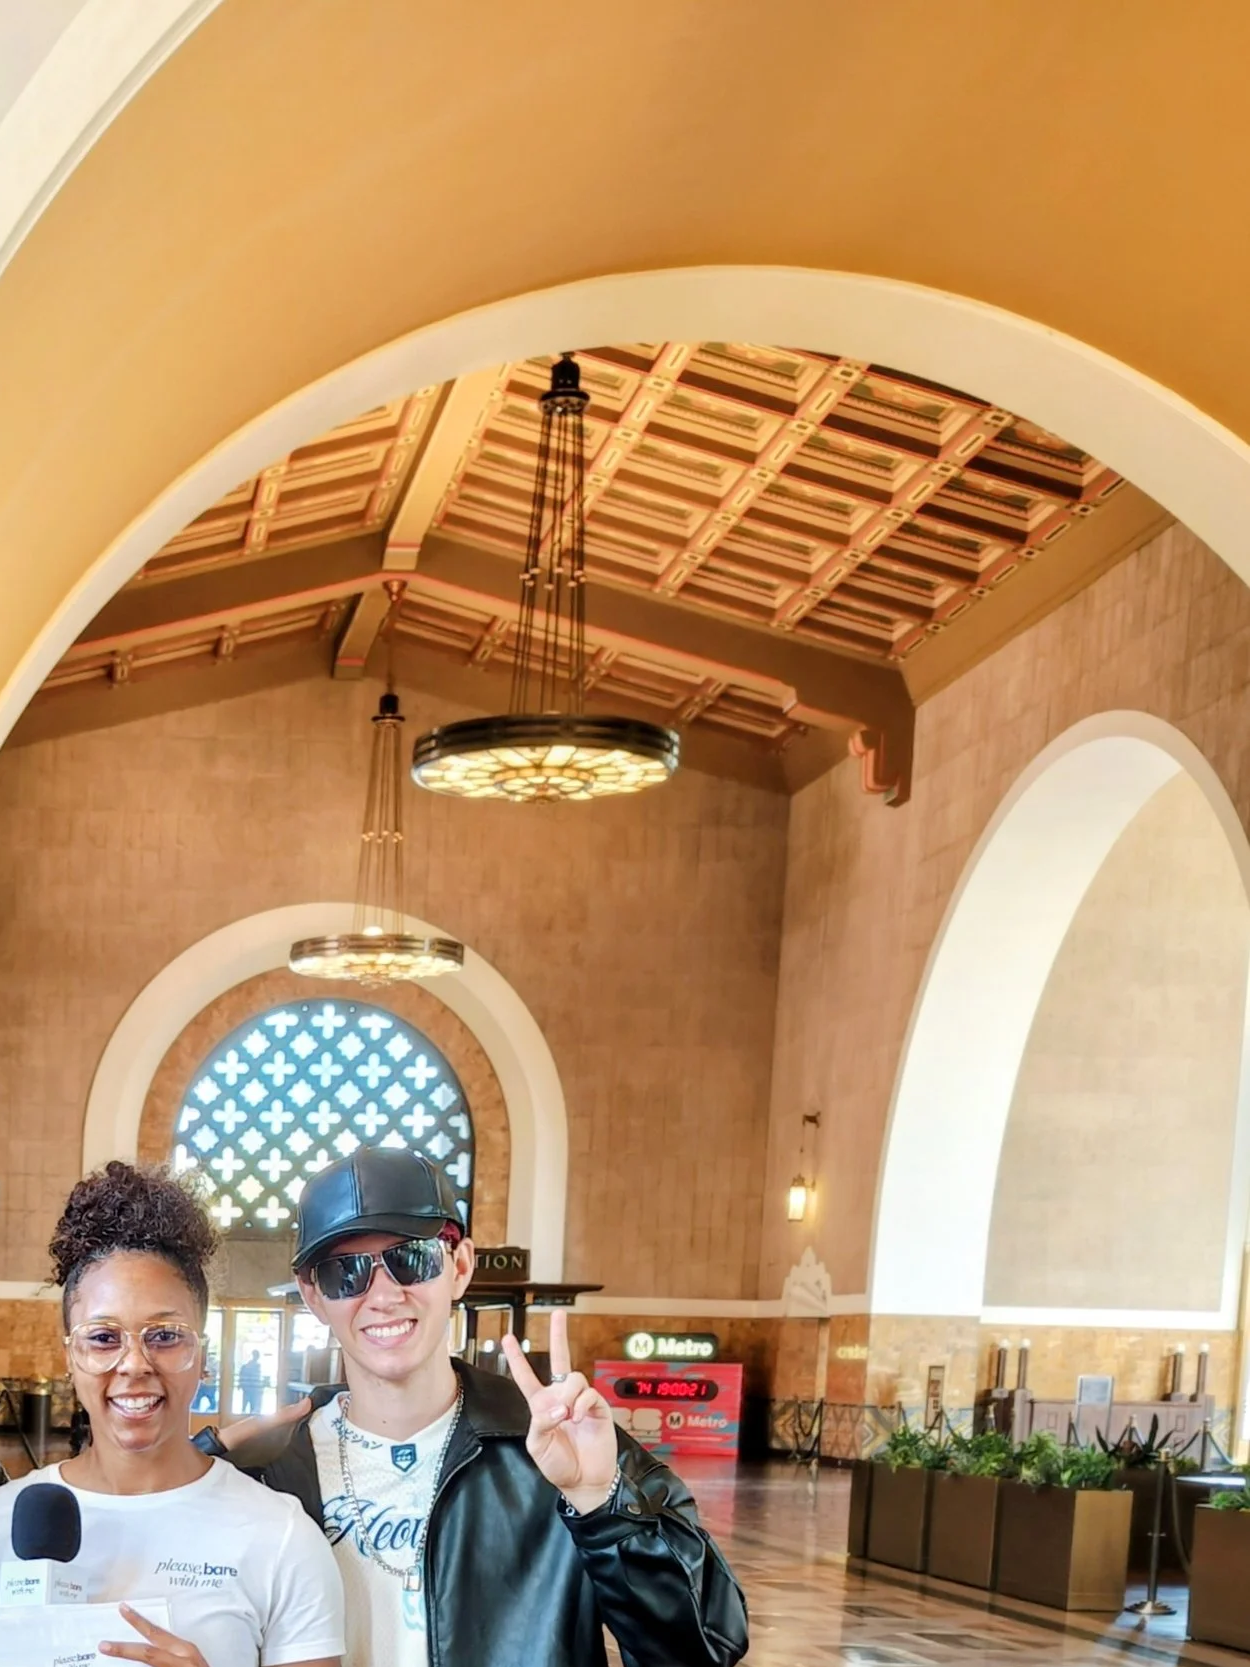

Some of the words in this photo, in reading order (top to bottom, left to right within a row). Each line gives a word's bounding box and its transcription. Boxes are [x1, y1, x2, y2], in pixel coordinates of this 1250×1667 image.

[474, 1254, 523, 1270] TION
[656, 1337, 714, 1357] Metro
[686, 1415, 729, 1429] Metro
[168, 1574, 199, 1588] with
[200, 1578, 224, 1589] me
